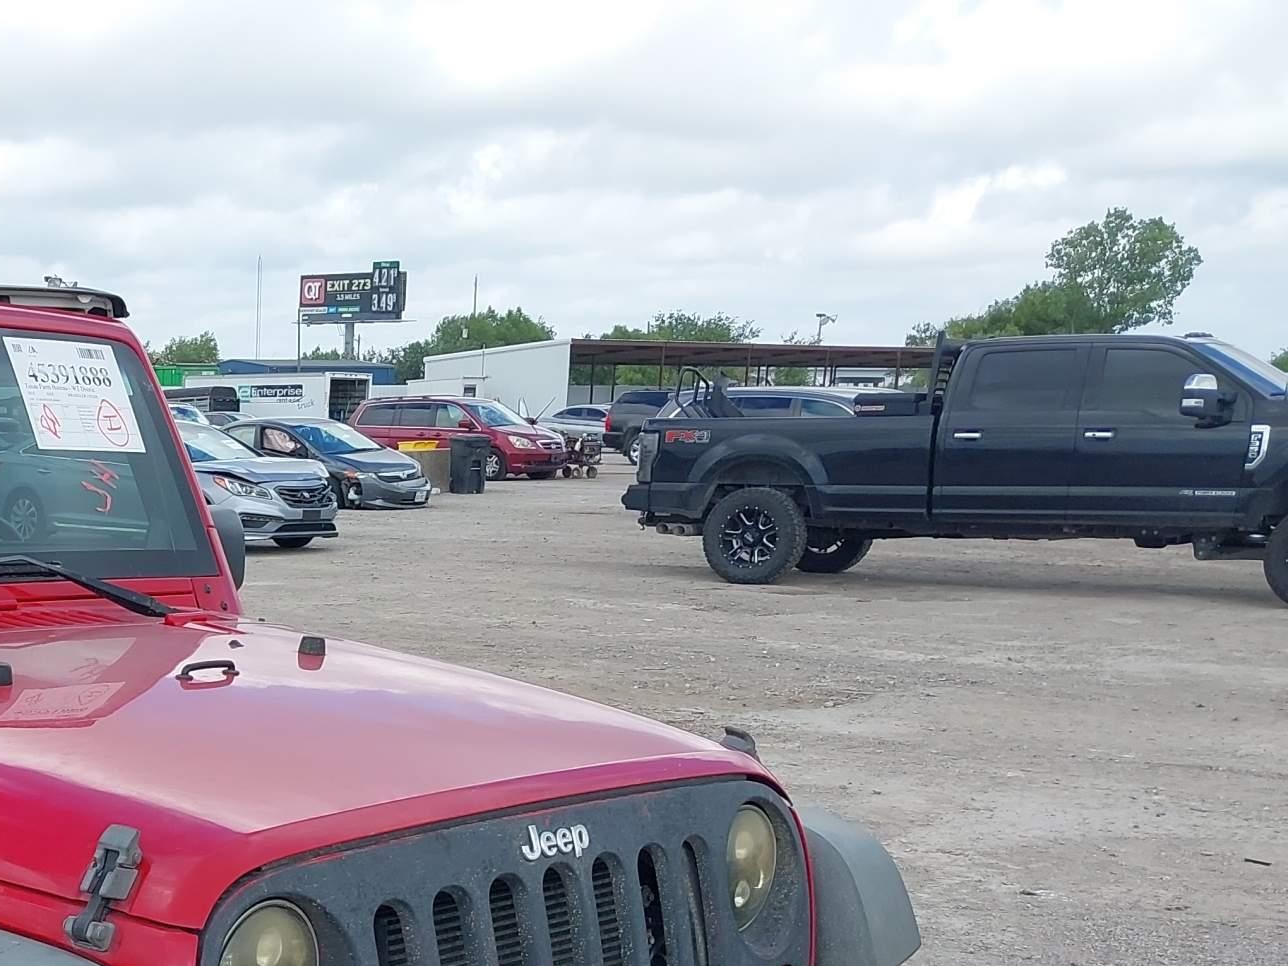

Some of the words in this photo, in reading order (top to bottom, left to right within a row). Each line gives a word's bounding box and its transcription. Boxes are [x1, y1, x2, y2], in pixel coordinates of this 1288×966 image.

[304, 282, 321, 300] QT
[327, 281, 349, 291] EXIT
[352, 279, 371, 290] 273
[28, 361, 112, 388] 45391888
[252, 385, 302, 397] Enterprise
[297, 399, 314, 410] truck
[521, 824, 590, 860] Jeep
